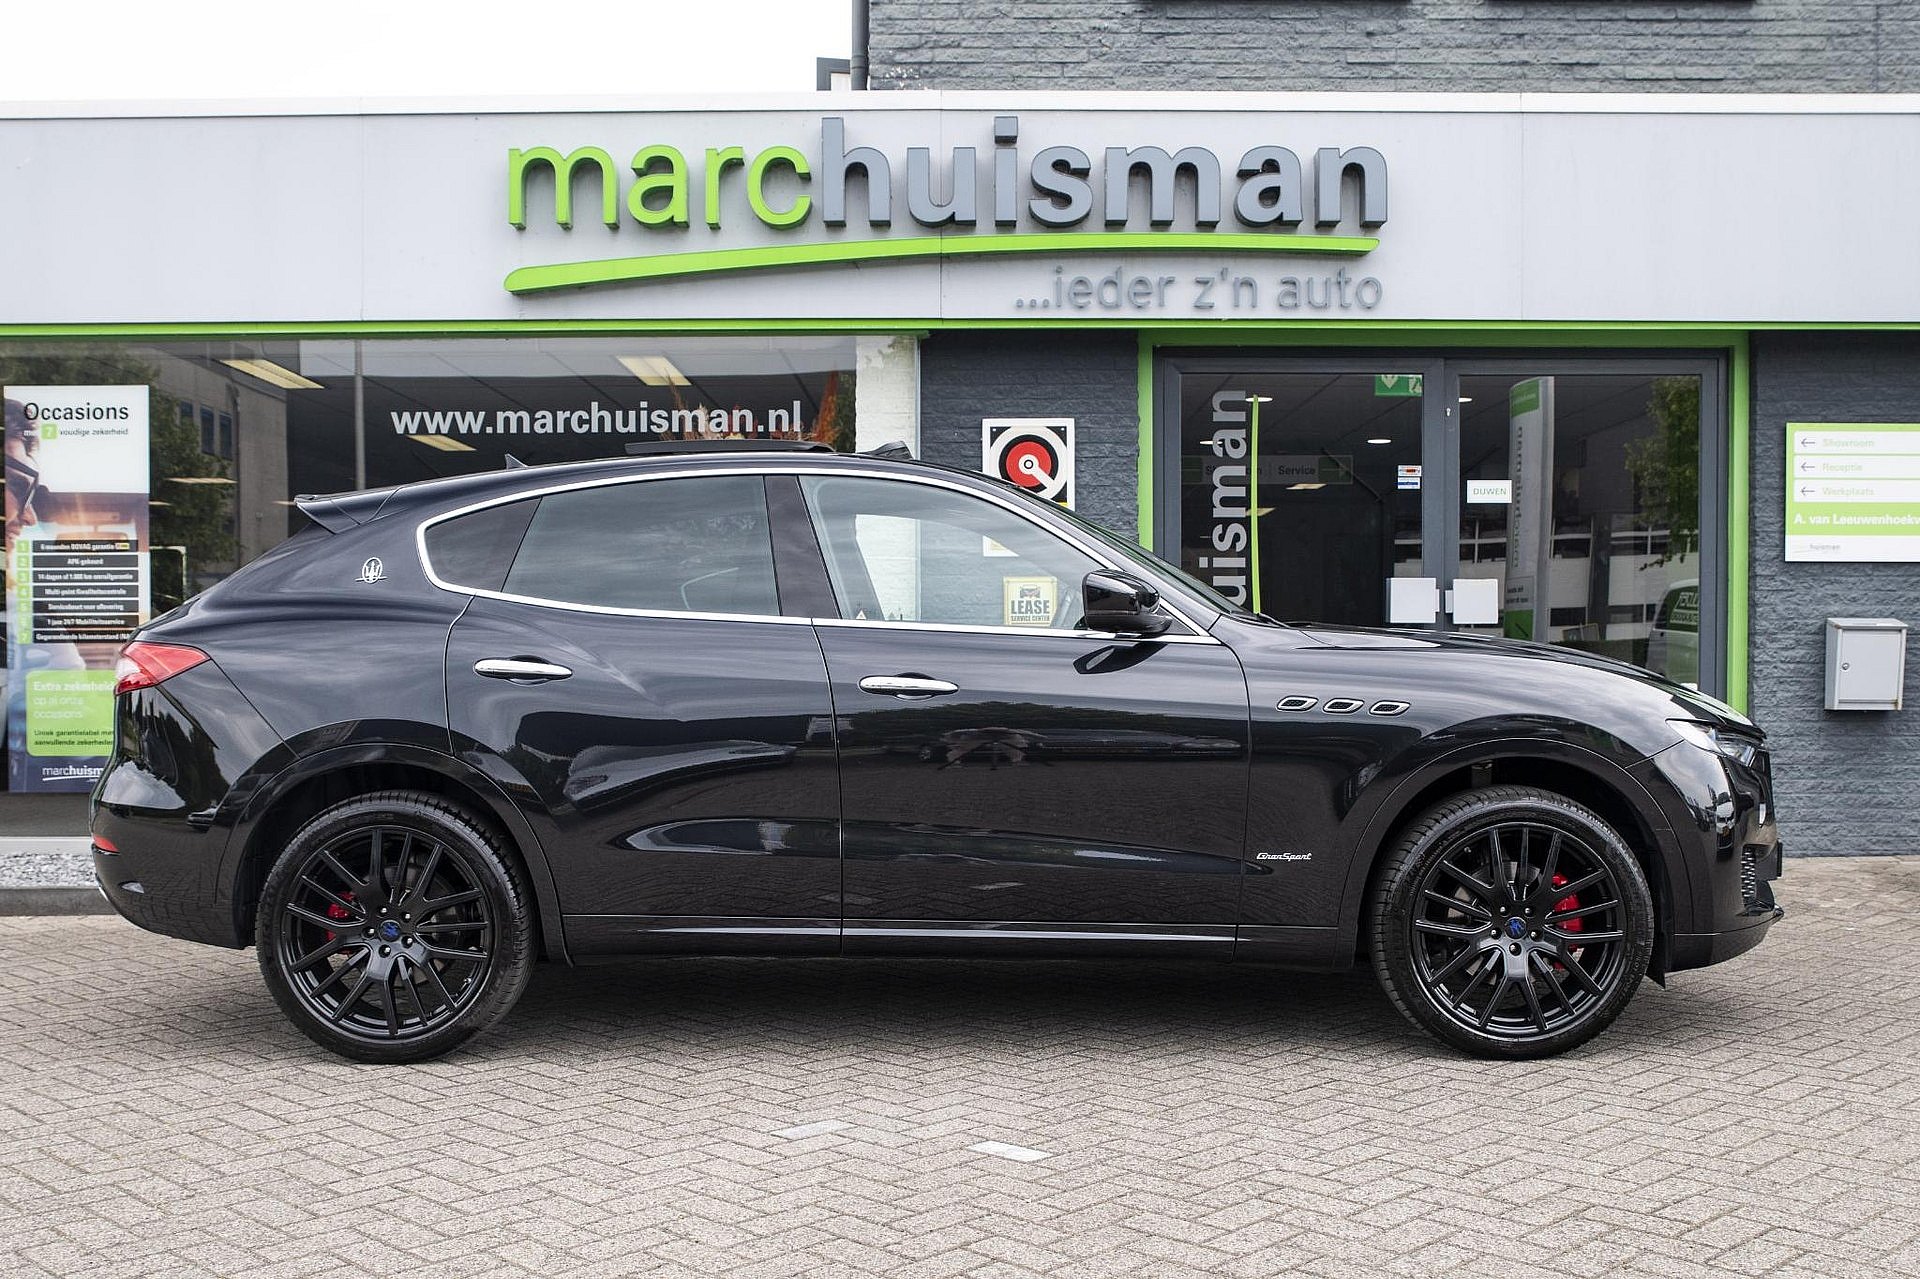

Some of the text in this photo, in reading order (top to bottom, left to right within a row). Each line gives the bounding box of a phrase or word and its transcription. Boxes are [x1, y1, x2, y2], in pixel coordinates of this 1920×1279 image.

[506, 116, 1389, 229] marchuisman
[1193, 267, 1259, 309] z'n
[1278, 267, 1383, 309] auto
[24, 402, 129, 420] Occasions
[391, 401, 800, 434] www.marchuisman.nl
[92, 427, 128, 436] zekerheid
[1822, 438, 1875, 447] Showroom
[1278, 465, 1316, 475] Service
[1822, 463, 1863, 472] Receptie
[1822, 487, 1875, 497] Werkplaats
[1793, 513, 1806, 525] A.
[1809, 515, 1829, 525] van
[1011, 599, 1050, 614] LEASE
[1256, 852, 1312, 861] GranSport
